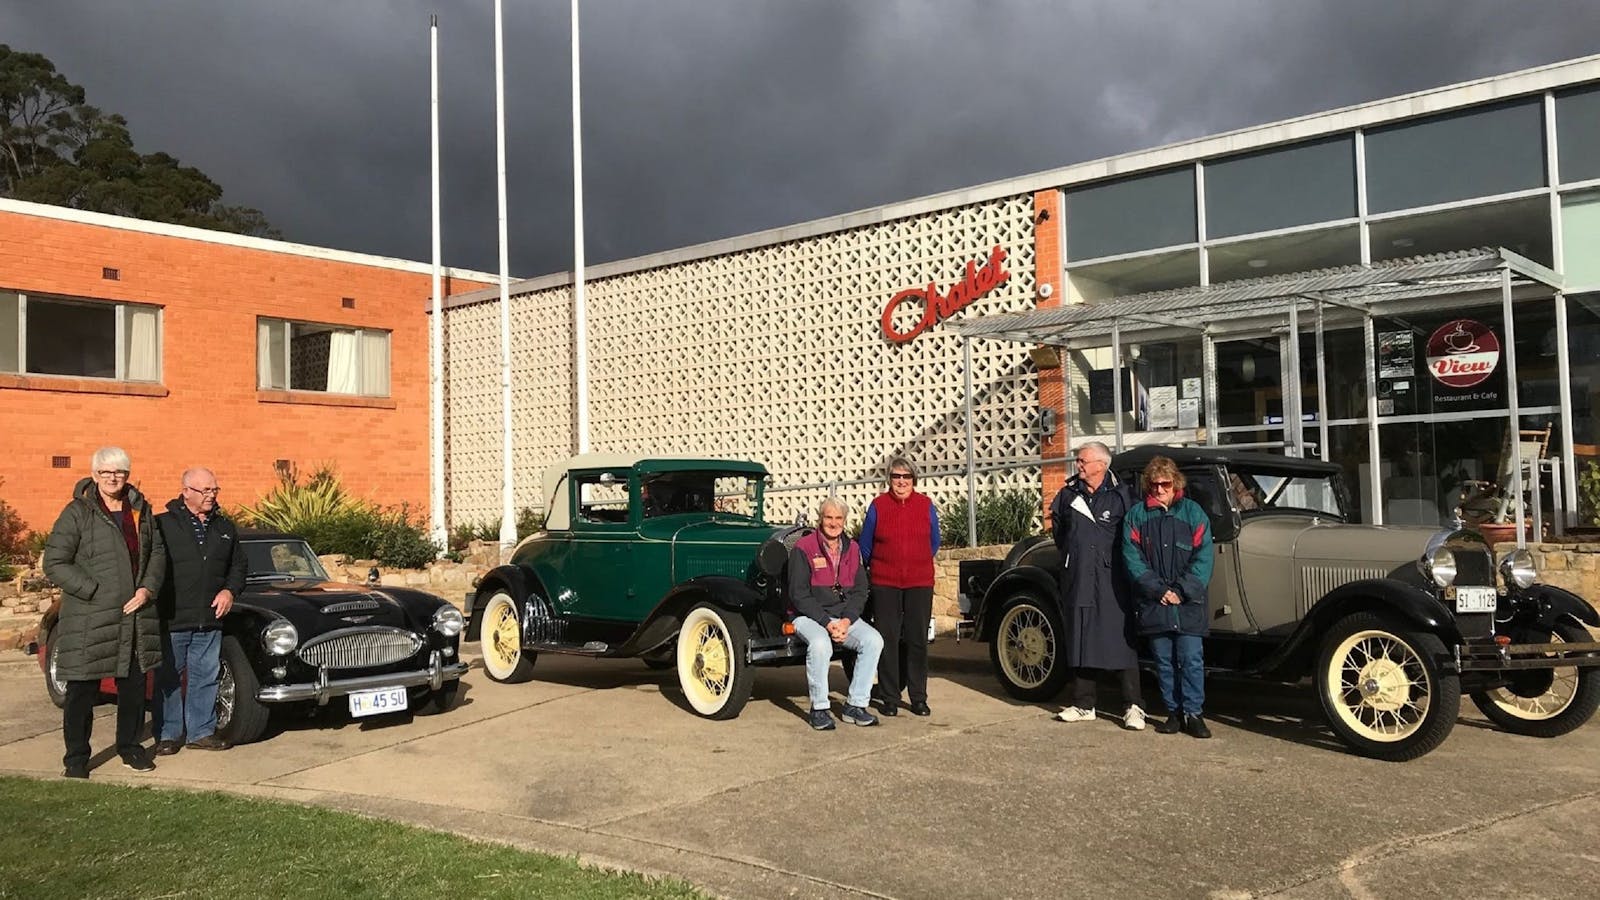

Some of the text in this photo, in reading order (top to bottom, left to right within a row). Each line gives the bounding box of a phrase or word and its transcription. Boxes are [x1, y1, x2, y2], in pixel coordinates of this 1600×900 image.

[881, 244, 1010, 342] Chalet
[1432, 359, 1492, 374] View
[1434, 394, 1472, 402] Restaurant
